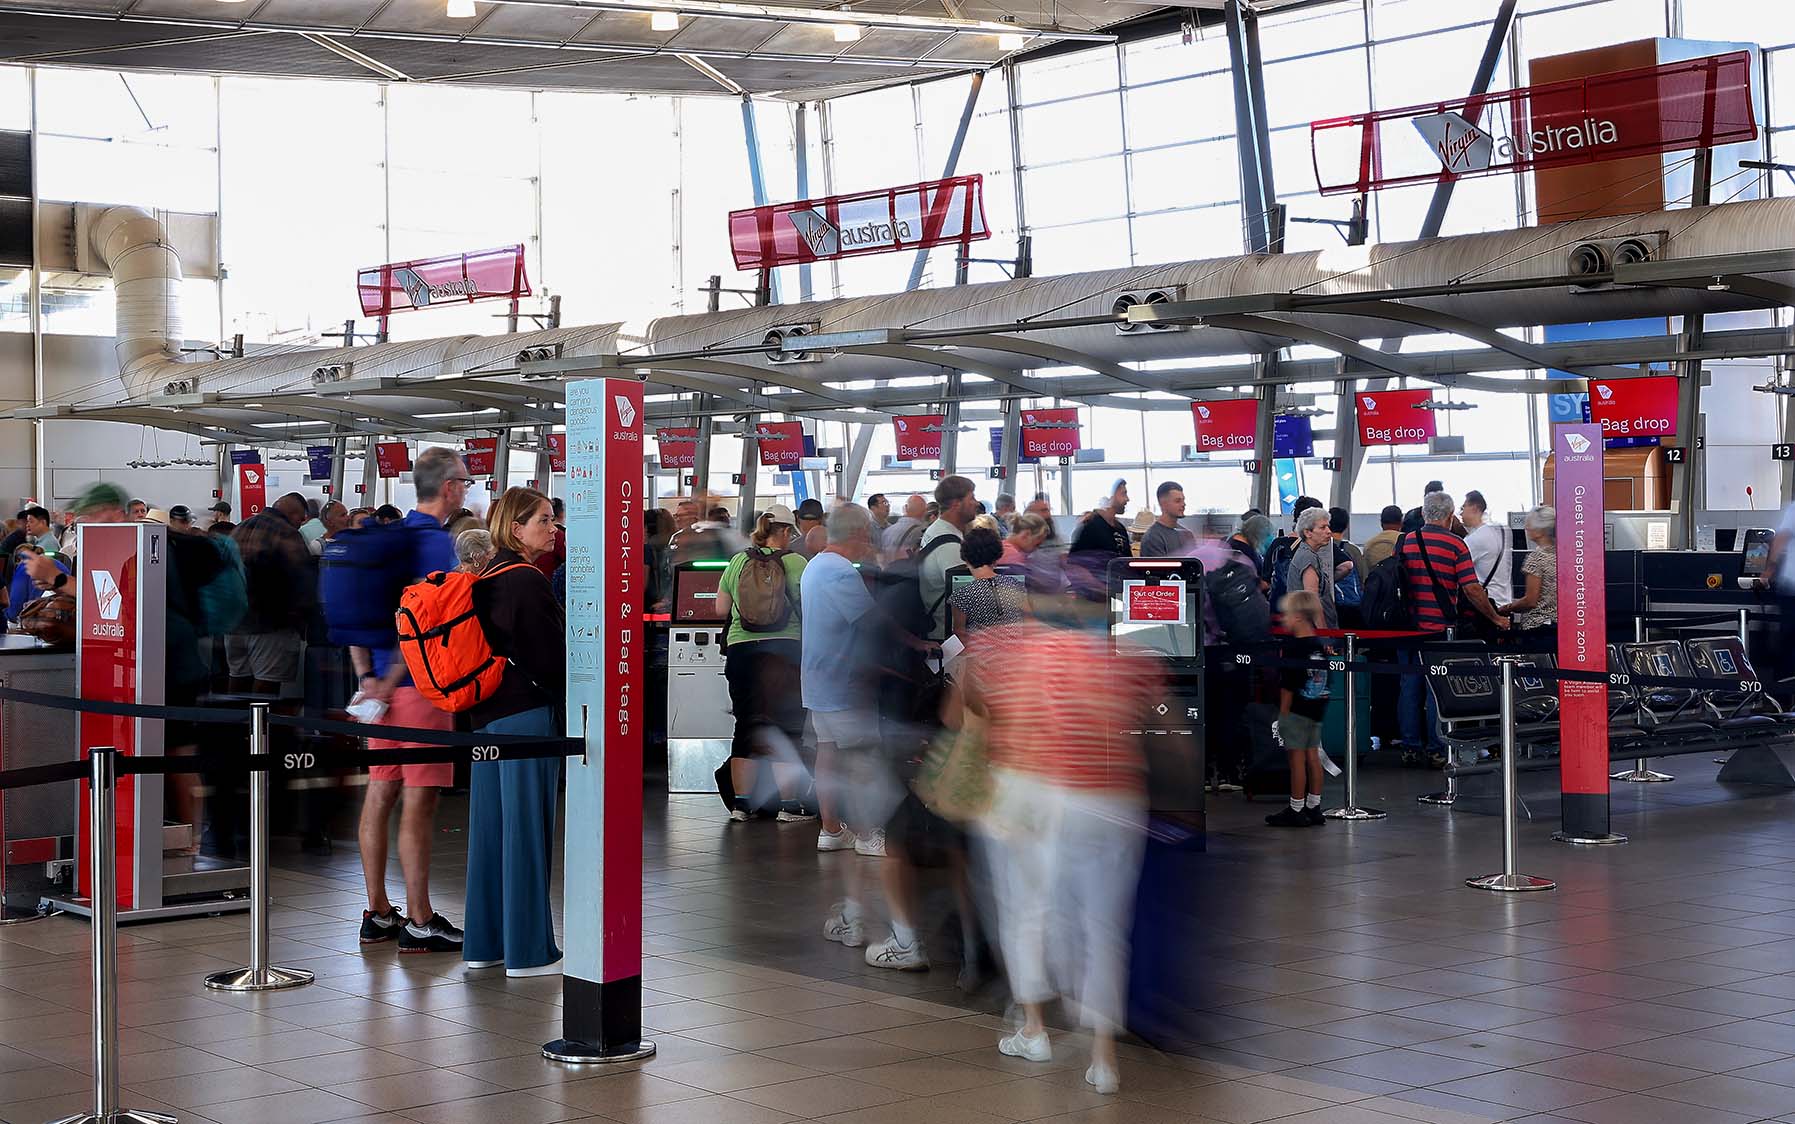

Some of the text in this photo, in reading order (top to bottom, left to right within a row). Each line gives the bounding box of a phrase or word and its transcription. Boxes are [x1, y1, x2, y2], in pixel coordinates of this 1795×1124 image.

[1437, 118, 1618, 167] Virgin australia
[805, 215, 912, 252] Virgin australia
[430, 279, 479, 299] australia
[569, 406, 599, 417] dangerous
[1600, 417, 1670, 433] Bag drop
[613, 431, 639, 442] australia
[1366, 425, 1426, 442] Bag drop
[1201, 433, 1254, 448] Bag drop
[901, 444, 940, 457] Bag drop
[1028, 440, 1073, 453] Bag drop
[1776, 446, 1790, 458] 13
[663, 454, 678, 465] Bag
[763, 449, 799, 463] Bag drop
[1059, 457, 1068, 465] 43
[1563, 454, 1595, 463] australia
[1667, 450, 1681, 461] 12
[835, 464, 842, 472] 42
[1245, 461, 1256, 471] 10
[1326, 459, 1337, 469] 11
[932, 471, 938, 480] 8
[993, 468, 999, 477] 9
[686, 477, 691, 485] 6
[734, 475, 739, 483] 7
[569, 545, 589, 555] are you
[569, 556, 591, 565] carrying
[569, 565, 596, 575] prohibited
[1573, 485, 1587, 662] Guest transportation zone
[618, 480, 632, 737] Check-in & Bag tags
[92, 623, 125, 637] australia
[1236, 653, 1251, 665] SYD
[1329, 661, 1346, 672] SYD
[1430, 665, 1448, 676] SYD
[1609, 673, 1630, 685] SYD
[1739, 680, 1762, 693] SYD
[471, 746, 500, 761] SYD
[284, 753, 315, 769] SYD
